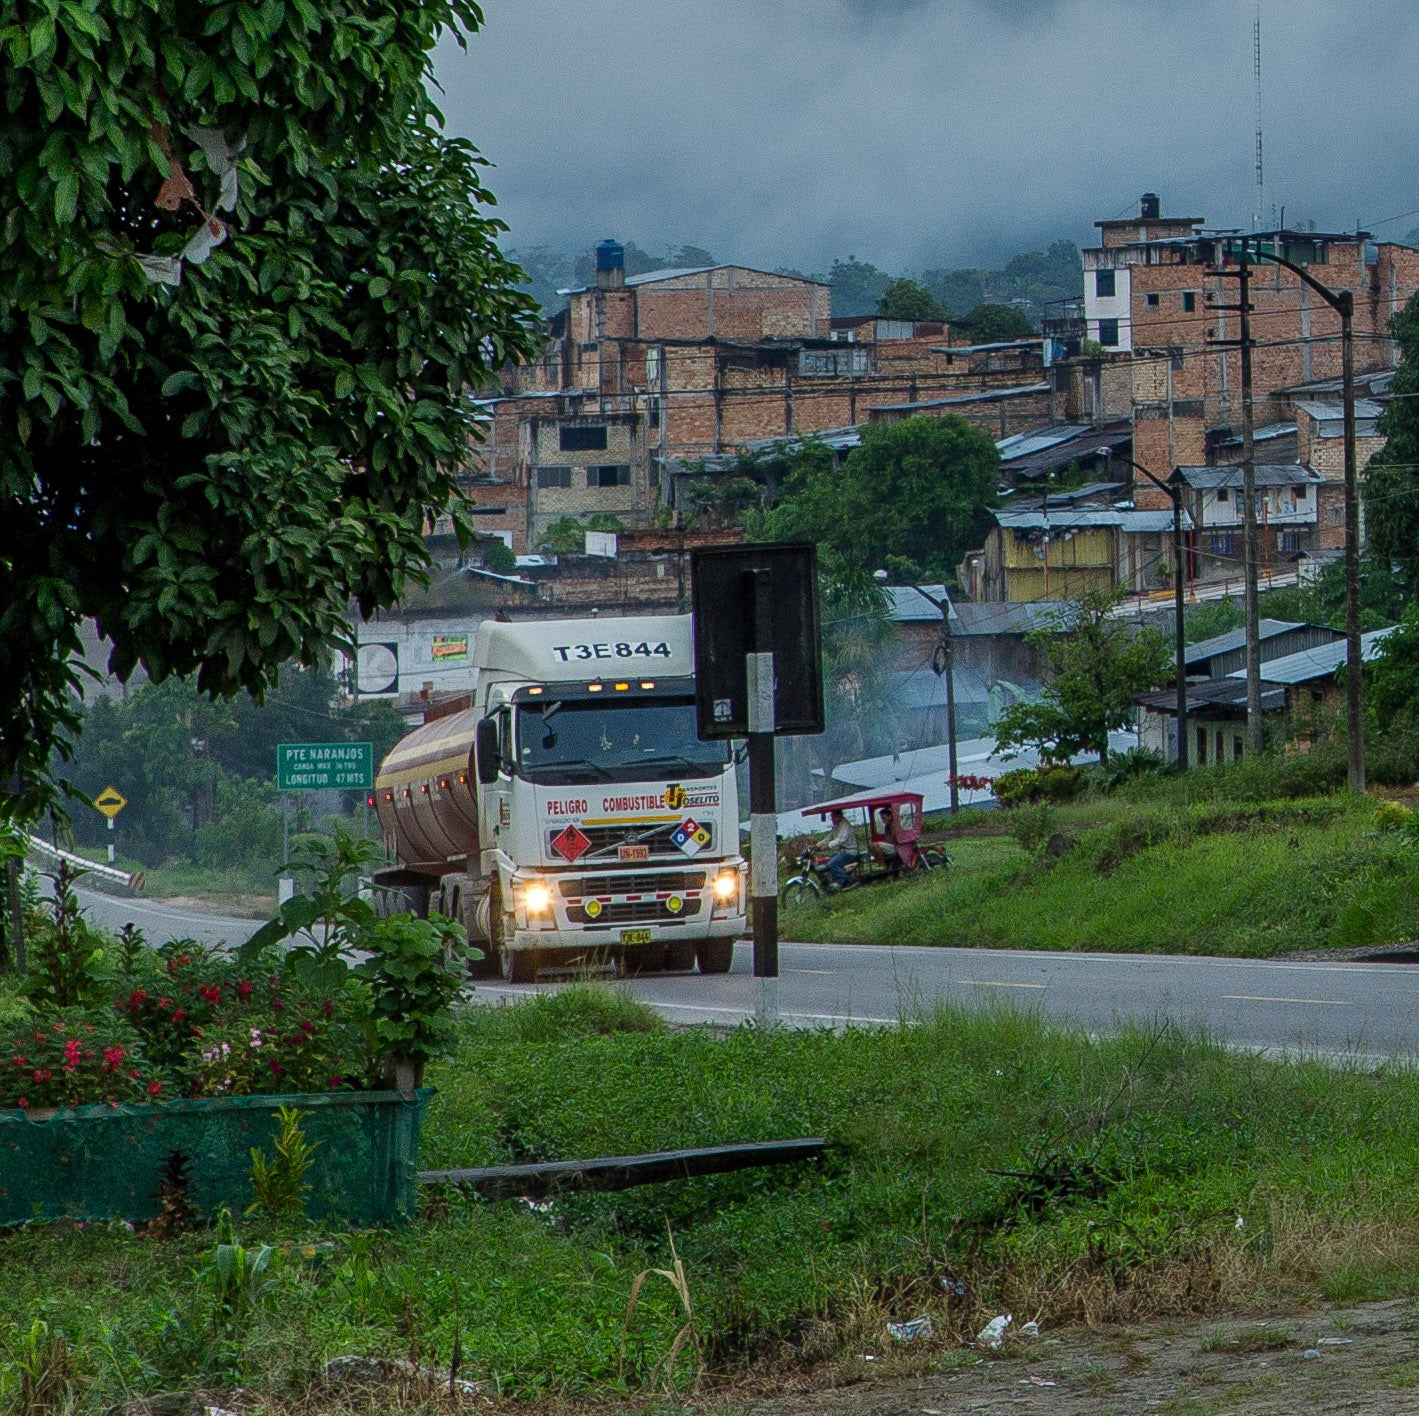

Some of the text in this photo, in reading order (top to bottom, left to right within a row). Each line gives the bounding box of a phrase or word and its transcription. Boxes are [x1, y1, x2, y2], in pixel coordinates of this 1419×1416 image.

[552, 642, 672, 662] T3E844
[286, 749, 363, 761] PTE NARANJOS
[286, 774, 328, 785] LONGITUD
[347, 773, 364, 784] MTS
[547, 795, 666, 816] PELIGRO COMBUSTIBLE
[687, 822, 695, 832] 2
[677, 833, 685, 842] 0
[697, 833, 705, 842] 0
